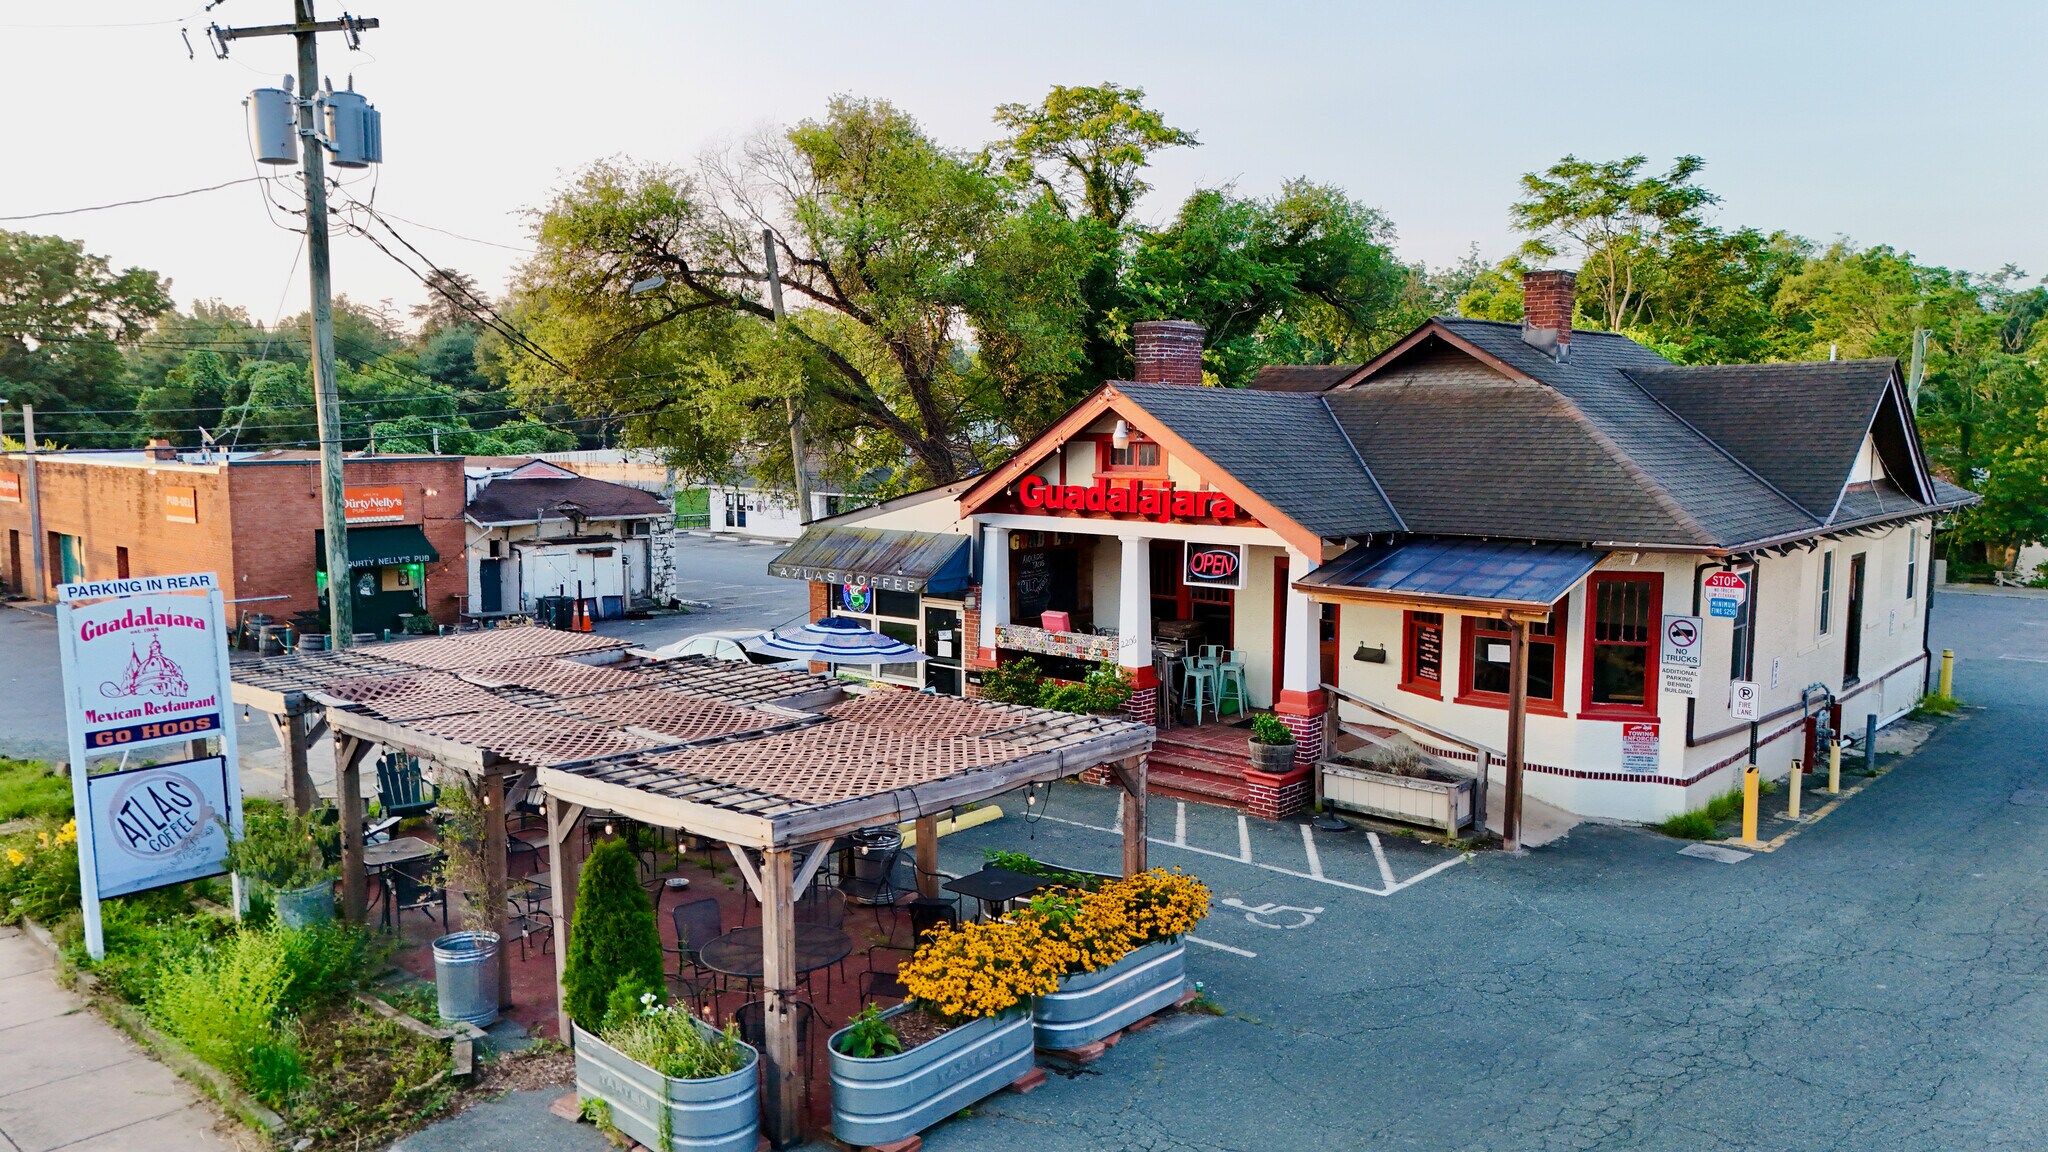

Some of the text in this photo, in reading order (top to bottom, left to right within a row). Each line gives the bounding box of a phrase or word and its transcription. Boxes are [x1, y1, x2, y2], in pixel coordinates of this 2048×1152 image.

[1019, 475, 1235, 523] Guadalajara
[378, 556, 410, 566] NELLY'S
[414, 555, 430, 563] PUB
[1191, 552, 1234, 576] OPEN
[67, 575, 211, 598] PARKING IN REAR
[779, 567, 916, 592] ATLAS COFFEE
[1712, 575, 1738, 586] STOP
[80, 606, 206, 641] Guadalajara
[1666, 654, 1698, 664] TRUCKS
[1661, 668, 1698, 676] ADDITIONAL
[1666, 674, 1693, 683] PARKING
[1664, 687, 1693, 695] BUILDING
[85, 694, 216, 724] Mexican Restaurant
[95, 717, 211, 746] GO HOOS
[117, 781, 193, 848] ATLAS
[148, 811, 198, 852] COFFEE
